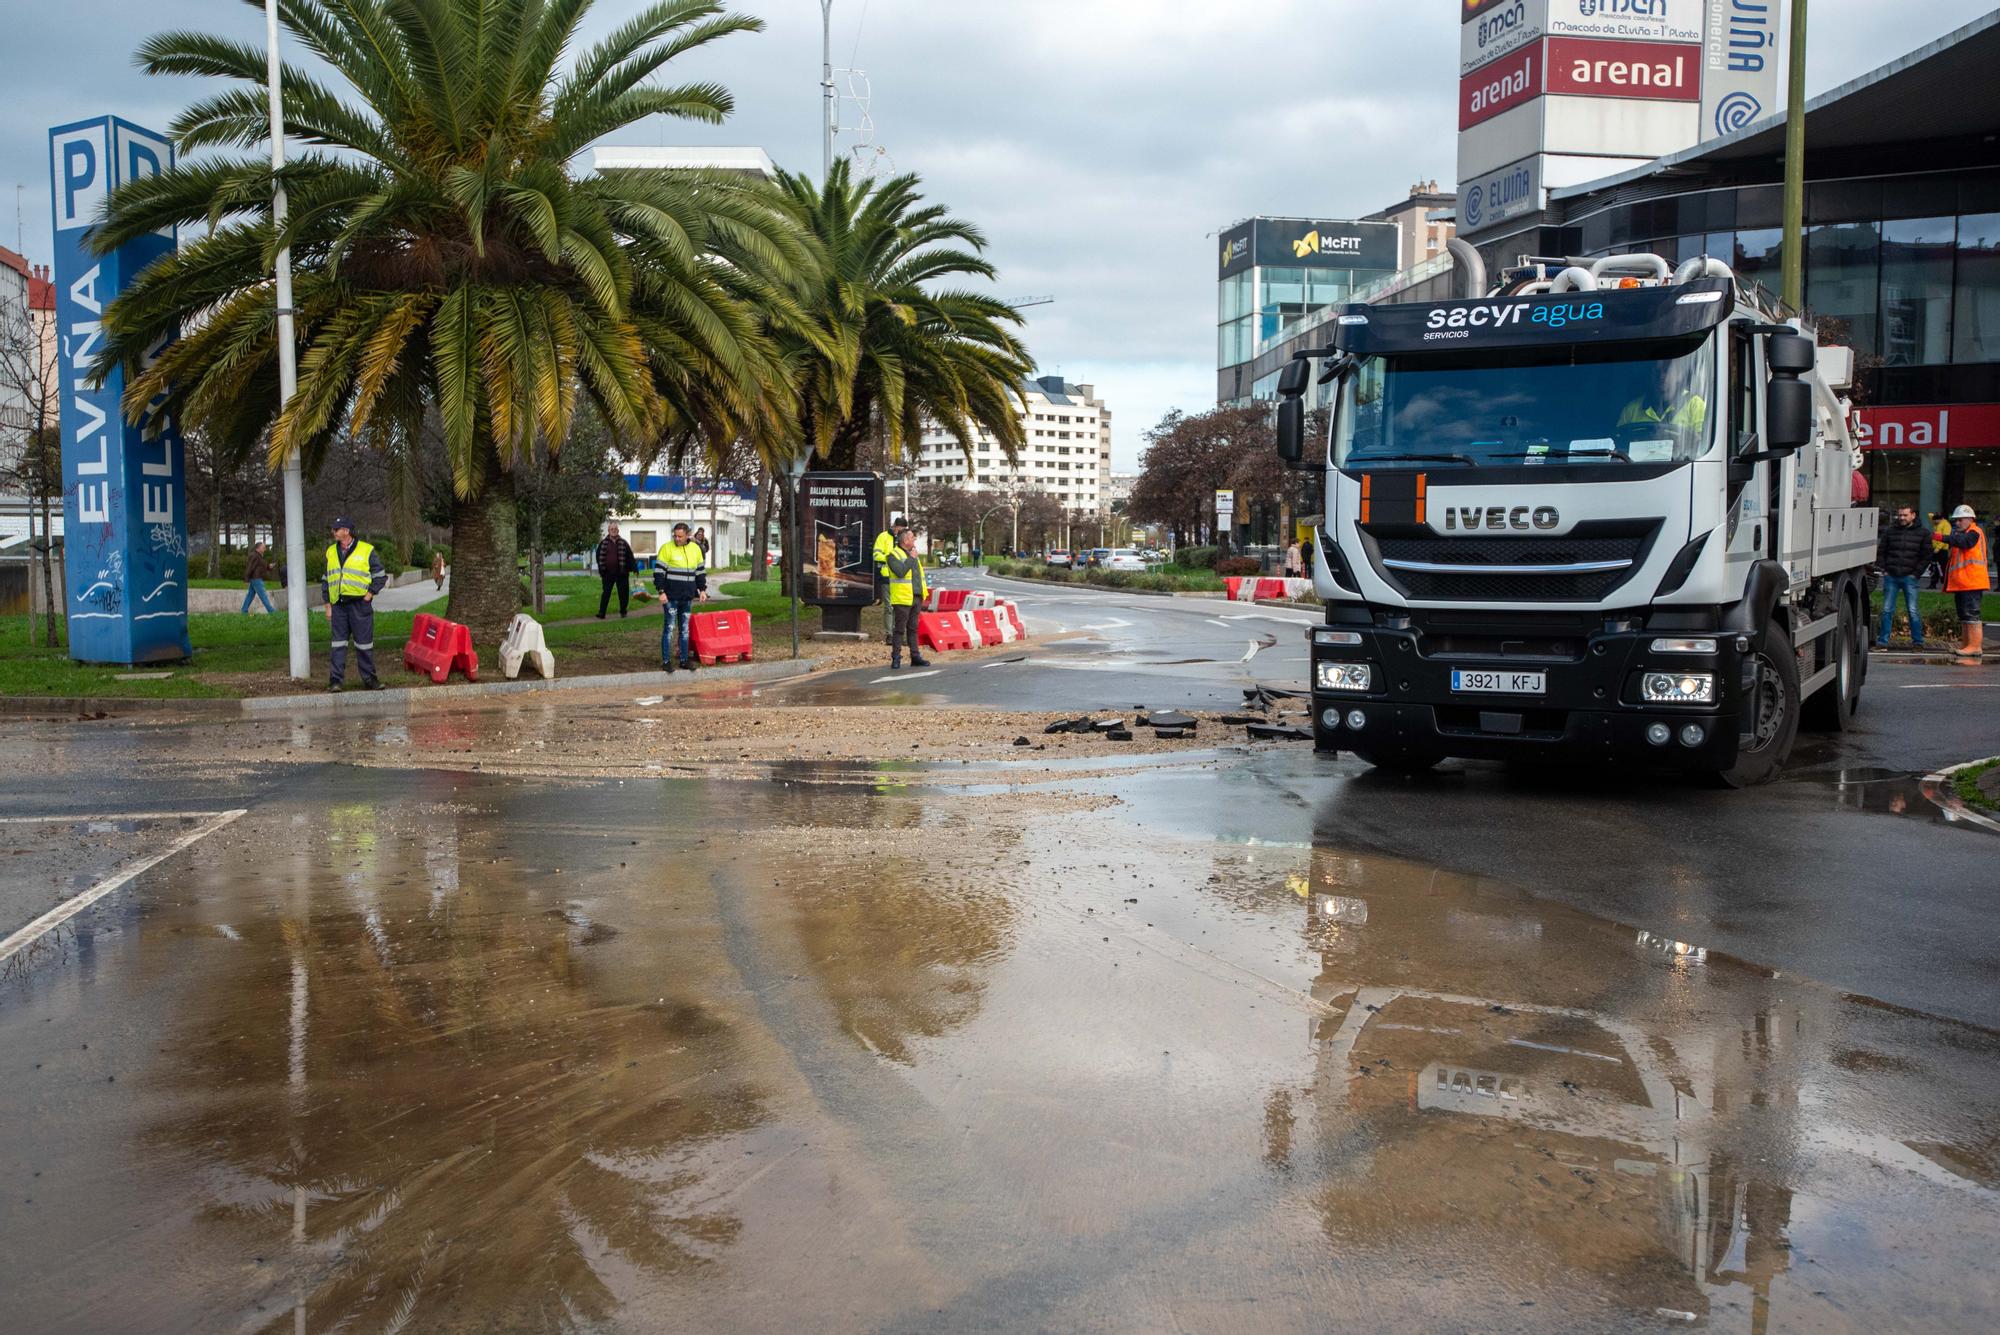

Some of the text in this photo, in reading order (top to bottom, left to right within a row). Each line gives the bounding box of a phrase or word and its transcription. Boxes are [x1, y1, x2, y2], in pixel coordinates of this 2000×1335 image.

[1552, 21, 1601, 33] Mercado
[1603, 24, 1615, 34] de
[1618, 24, 1651, 36] Elviña
[1669, 29, 1699, 39] Planta
[1709, 0, 1725, 70] omercial
[1571, 56, 1684, 87] arenal
[1471, 57, 1531, 112] arenal
[64, 139, 96, 219] P
[1321, 236, 1361, 249] McFIT
[1426, 303, 1604, 329] sacyr agua
[1423, 330, 1469, 340] SERVICIOS
[63, 263, 110, 523] ELVIÑA
[1859, 410, 1949, 446] enal
[809, 486, 844, 496] BALLANTINE'S
[850, 485, 866, 496] AÑOS.
[809, 497, 830, 507] PERDÓN
[830, 499, 841, 507] POR
[848, 499, 868, 508] ESPERA.
[1445, 505, 1560, 530] IVECO
[1465, 673, 1540, 691] 3921 KFJ
